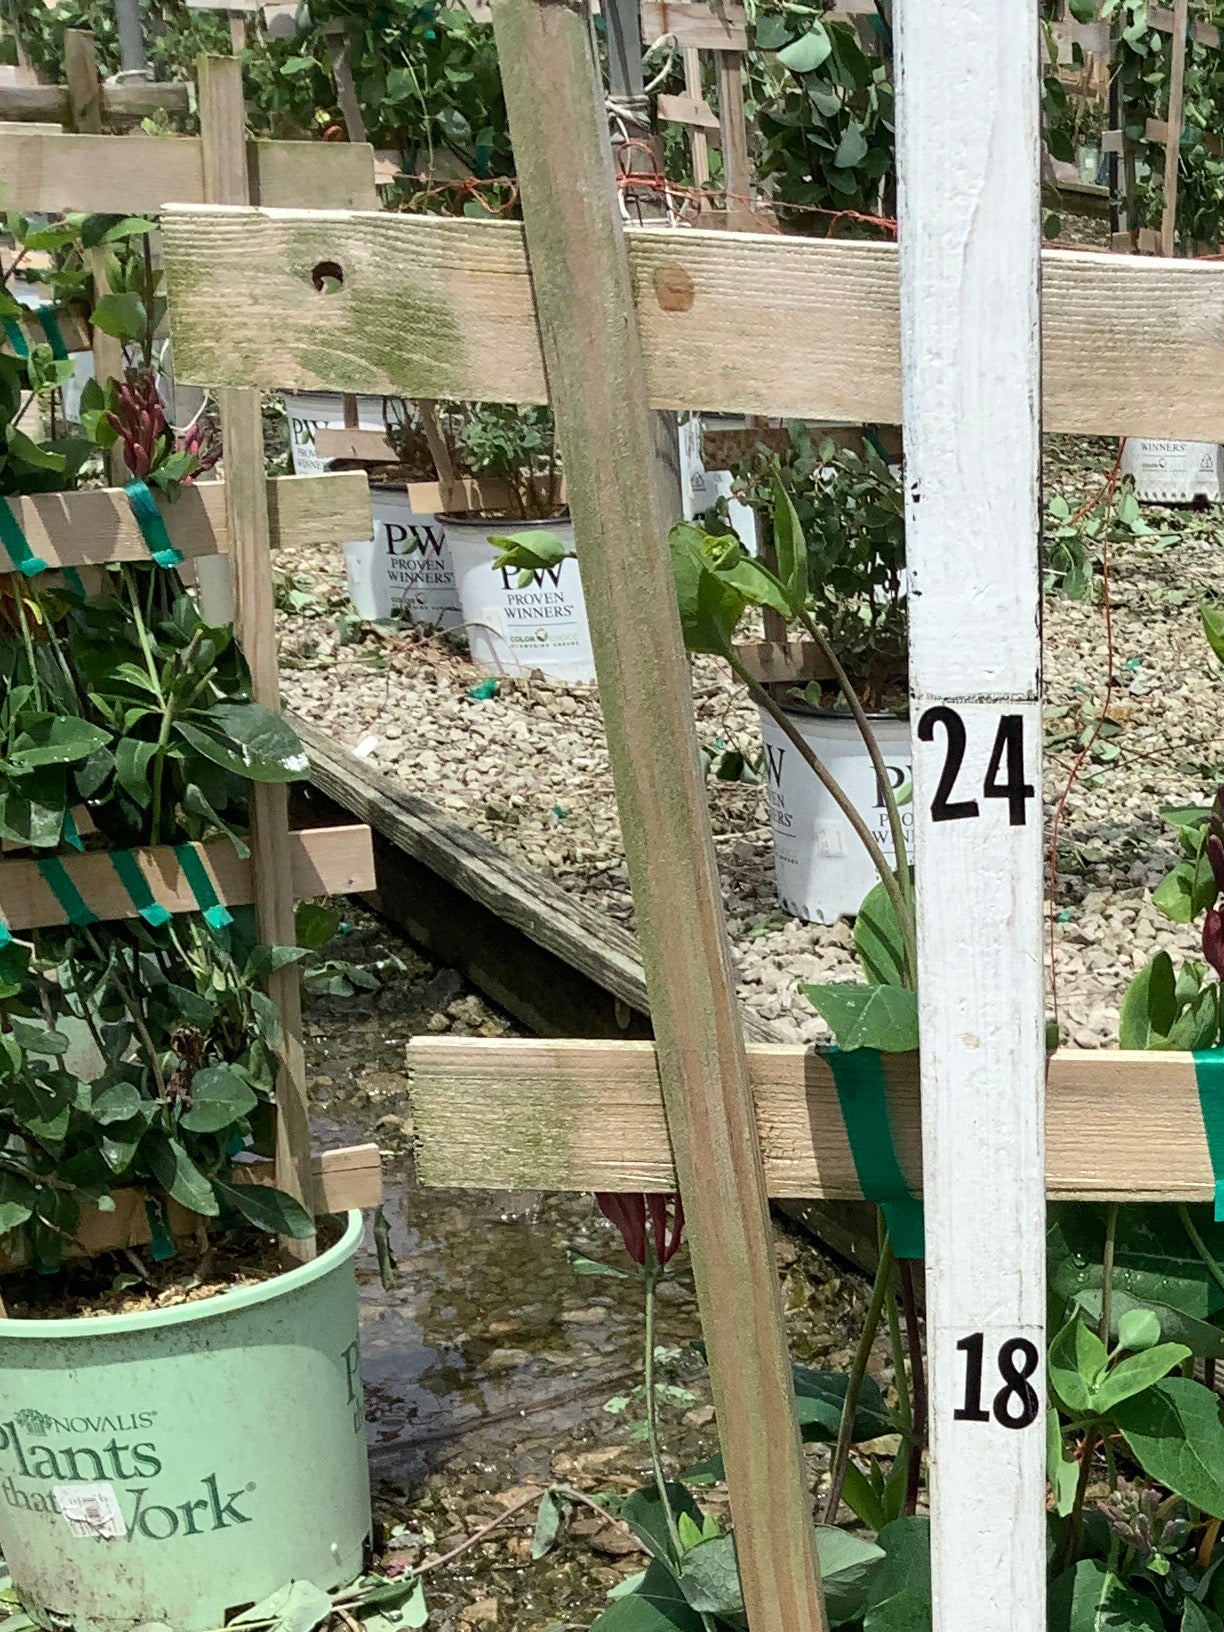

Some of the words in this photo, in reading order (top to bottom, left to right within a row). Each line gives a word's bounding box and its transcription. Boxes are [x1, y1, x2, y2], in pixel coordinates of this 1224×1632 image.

[1141, 442, 1187, 452] WINNERS
[382, 523, 446, 556] PW
[391, 558, 445, 571] PROVEN
[387, 569, 454, 584] WINNERS
[506, 592, 565, 606] PROVEN
[503, 605, 573, 620] WINNERS
[917, 705, 1035, 826] 24
[953, 1332, 1039, 1430] 18
[2, 1476, 62, 1515] that
[97, 1472, 253, 1542] ork
